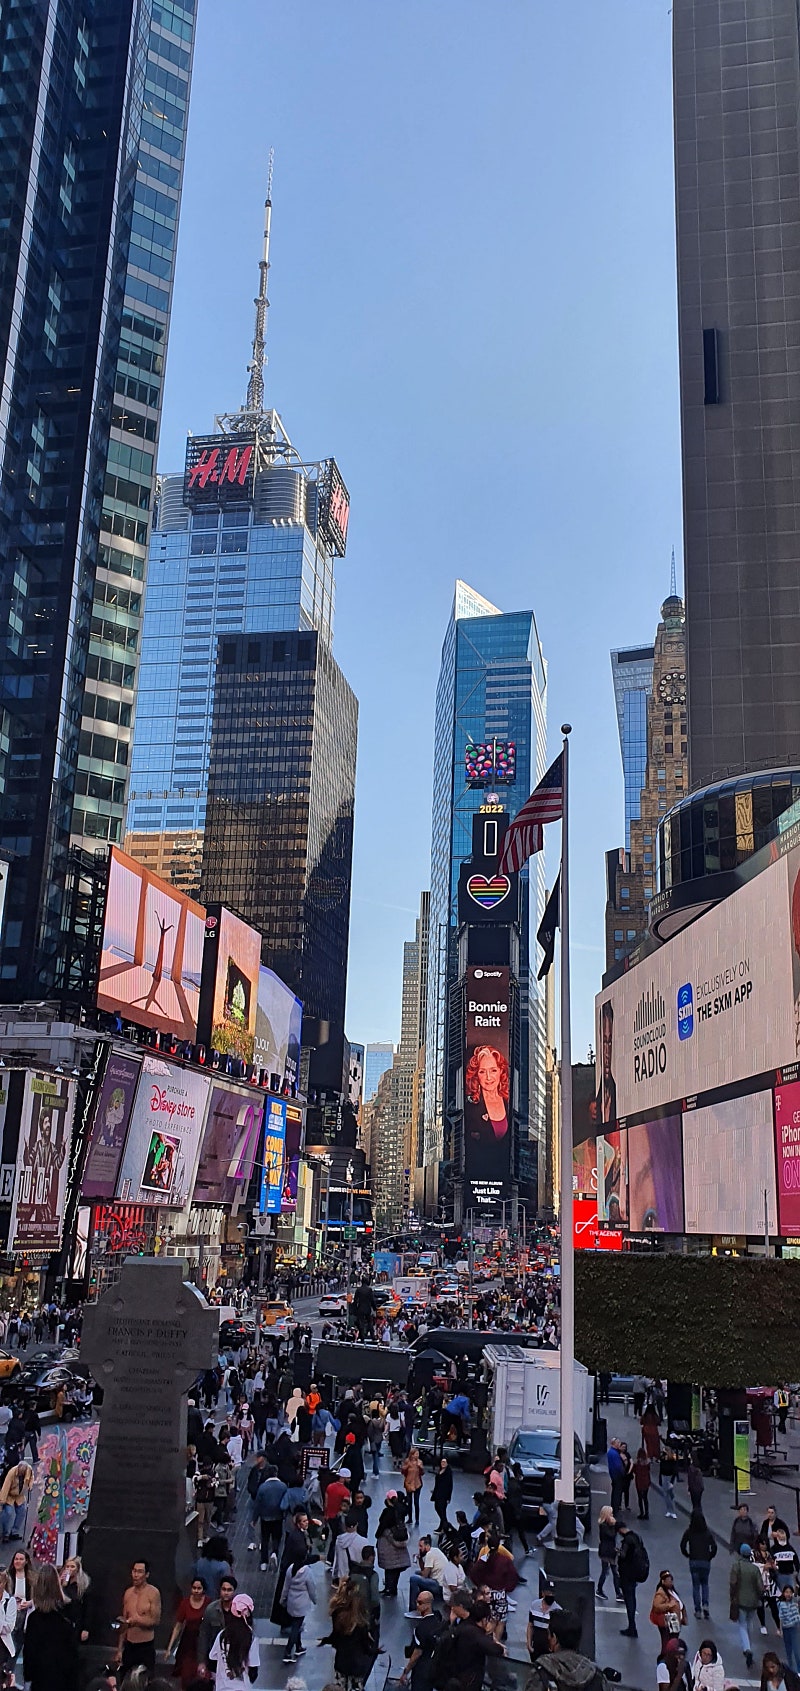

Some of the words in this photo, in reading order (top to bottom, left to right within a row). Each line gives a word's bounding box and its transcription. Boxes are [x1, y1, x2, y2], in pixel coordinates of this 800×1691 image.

[188, 446, 253, 488] H&M
[480, 804, 504, 814] 2022
[696, 965, 737, 1000] EXCLUSIVELY
[739, 958, 750, 976] ON
[468, 1000, 508, 1012] Bonnie
[678, 1002, 693, 1022] sxm
[696, 1002, 712, 1022] THE
[714, 991, 732, 1016] SXM
[734, 980, 752, 1006] APP
[474, 1016, 501, 1026] Raitt
[634, 1024, 666, 1050] SOUNDCLOUD
[634, 1043, 666, 1084] RADIO
[150, 1084, 177, 1122] Disney
[177, 1101, 195, 1118] store
[146, 1118, 162, 1128] PHOTO
[165, 1122, 192, 1134] EXPERIENCE
[108, 1326, 145, 1337] FRANCIS
[156, 1329, 188, 1339] DUFFY
